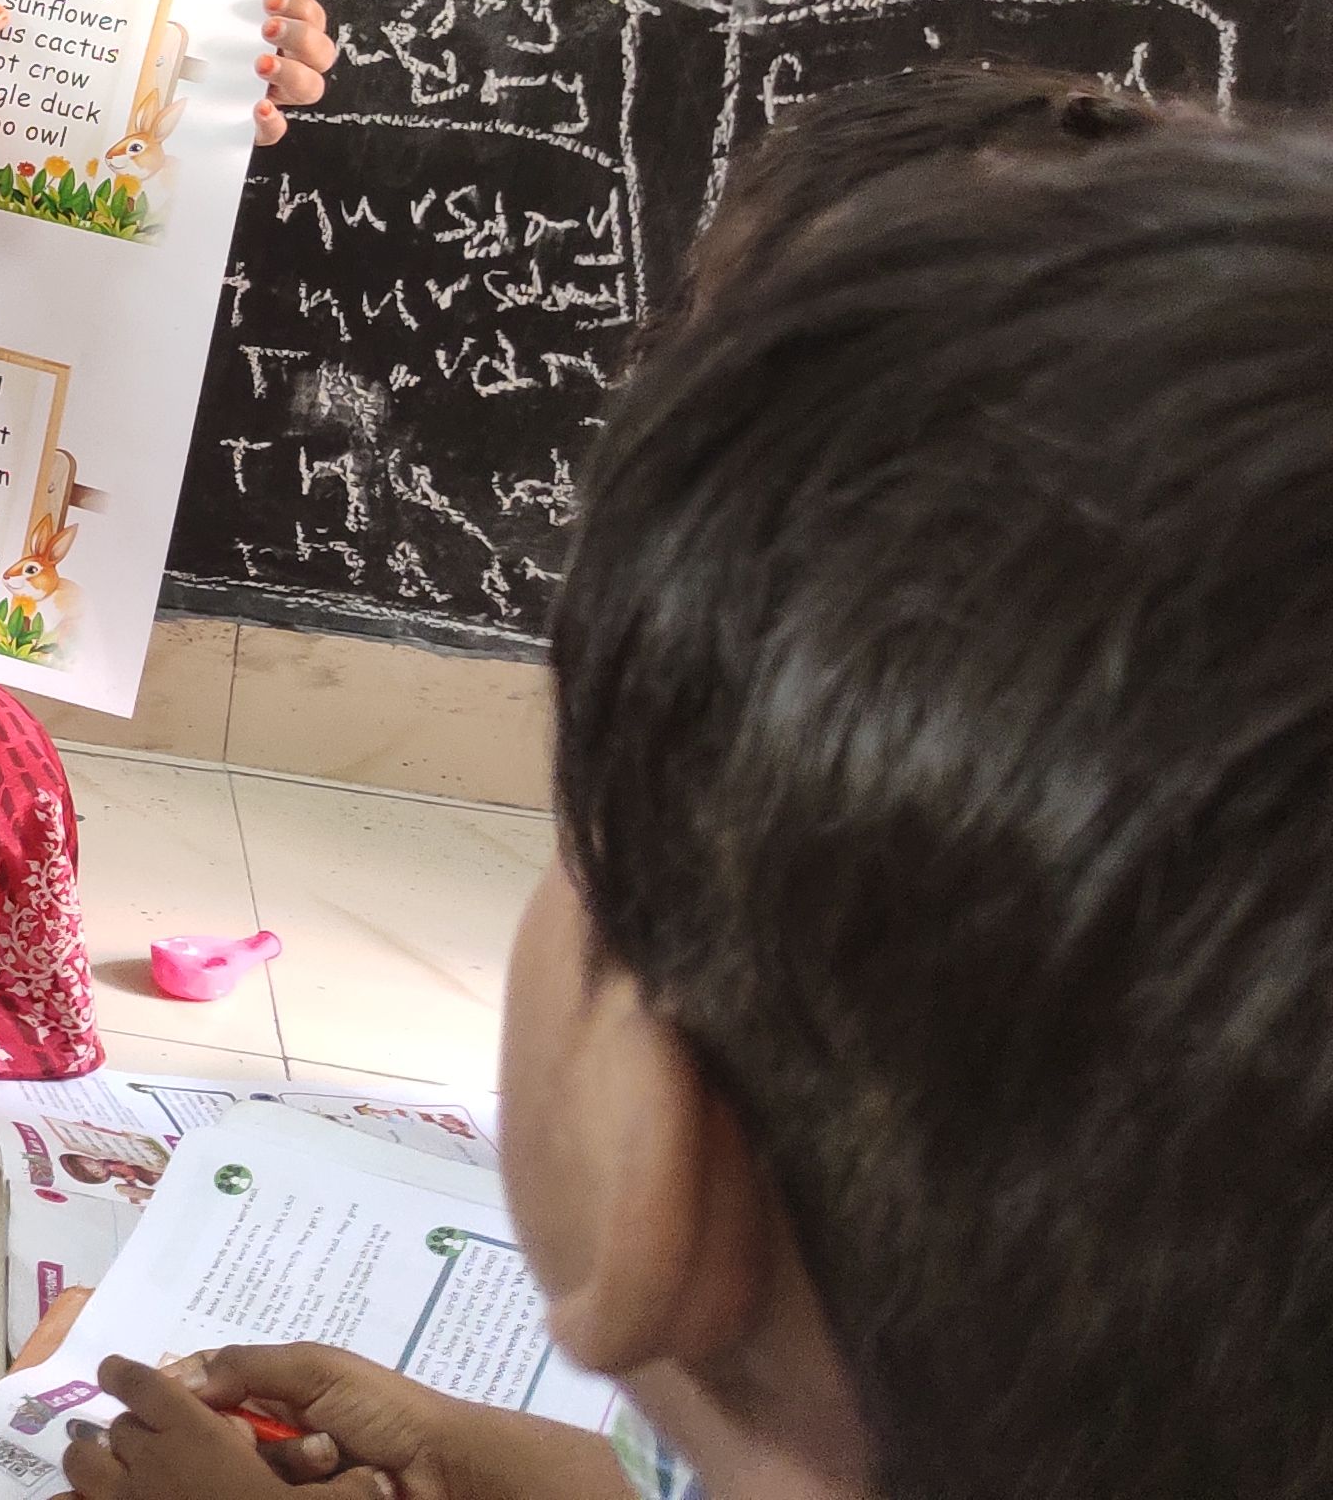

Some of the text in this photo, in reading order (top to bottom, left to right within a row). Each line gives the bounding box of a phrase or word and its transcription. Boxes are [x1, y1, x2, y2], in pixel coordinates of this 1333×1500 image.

[34, 31, 119, 64] cactus
[28, 59, 90, 90] crow
[41, 91, 102, 124] duck
[25, 125, 68, 148] owl
